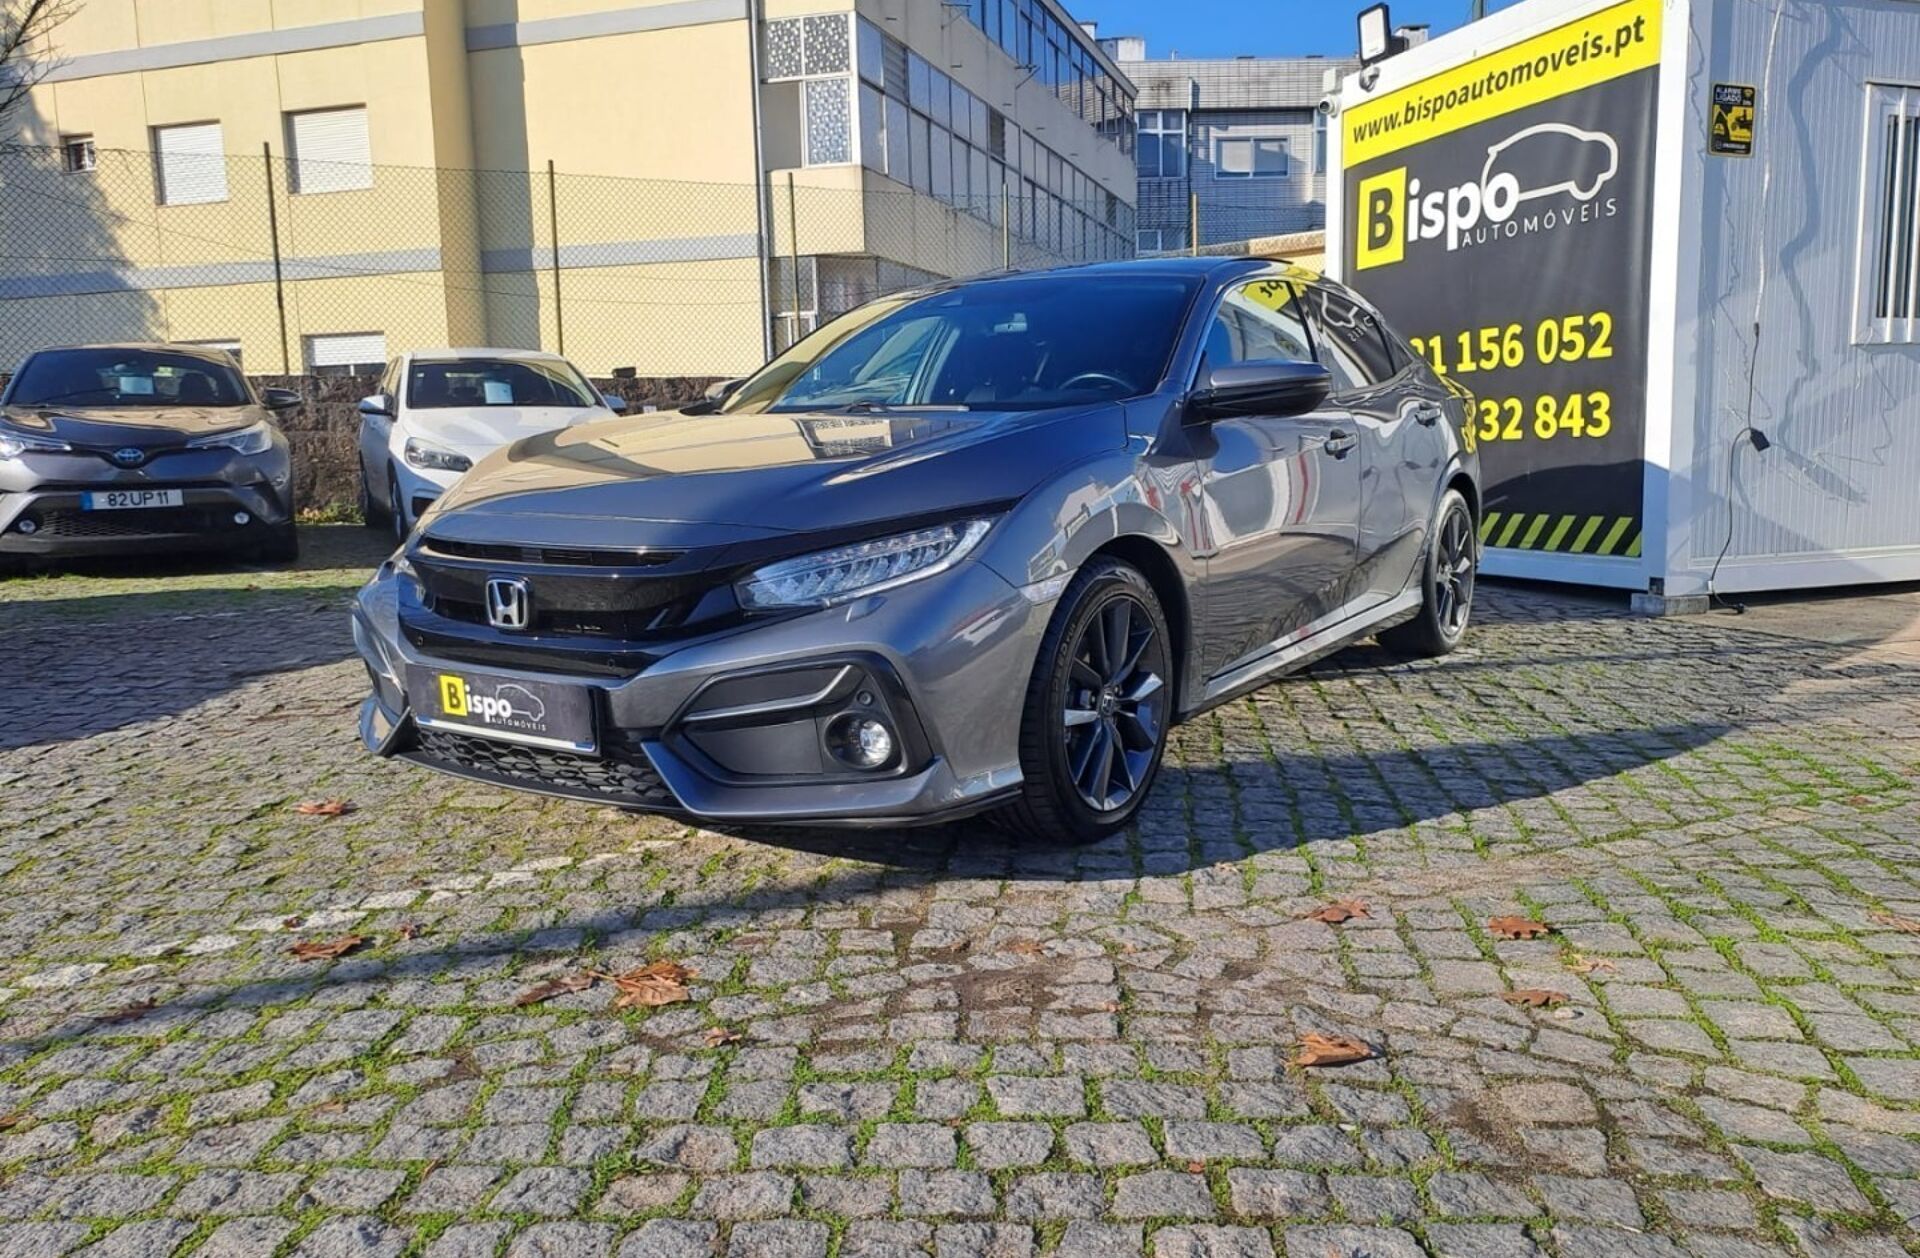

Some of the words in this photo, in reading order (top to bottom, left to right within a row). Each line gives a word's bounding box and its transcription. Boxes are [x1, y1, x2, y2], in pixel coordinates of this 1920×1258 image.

[1352, 14, 1645, 144] www.bispoautomoveis.pt
[1366, 172, 1520, 252] Bispo
[1461, 197, 1617, 248] AUTOMÓVEIS
[1456, 323, 1525, 373] 156
[1536, 311, 1613, 365] 052
[1534, 391, 1611, 439] 843
[446, 681, 513, 723] Bispo
